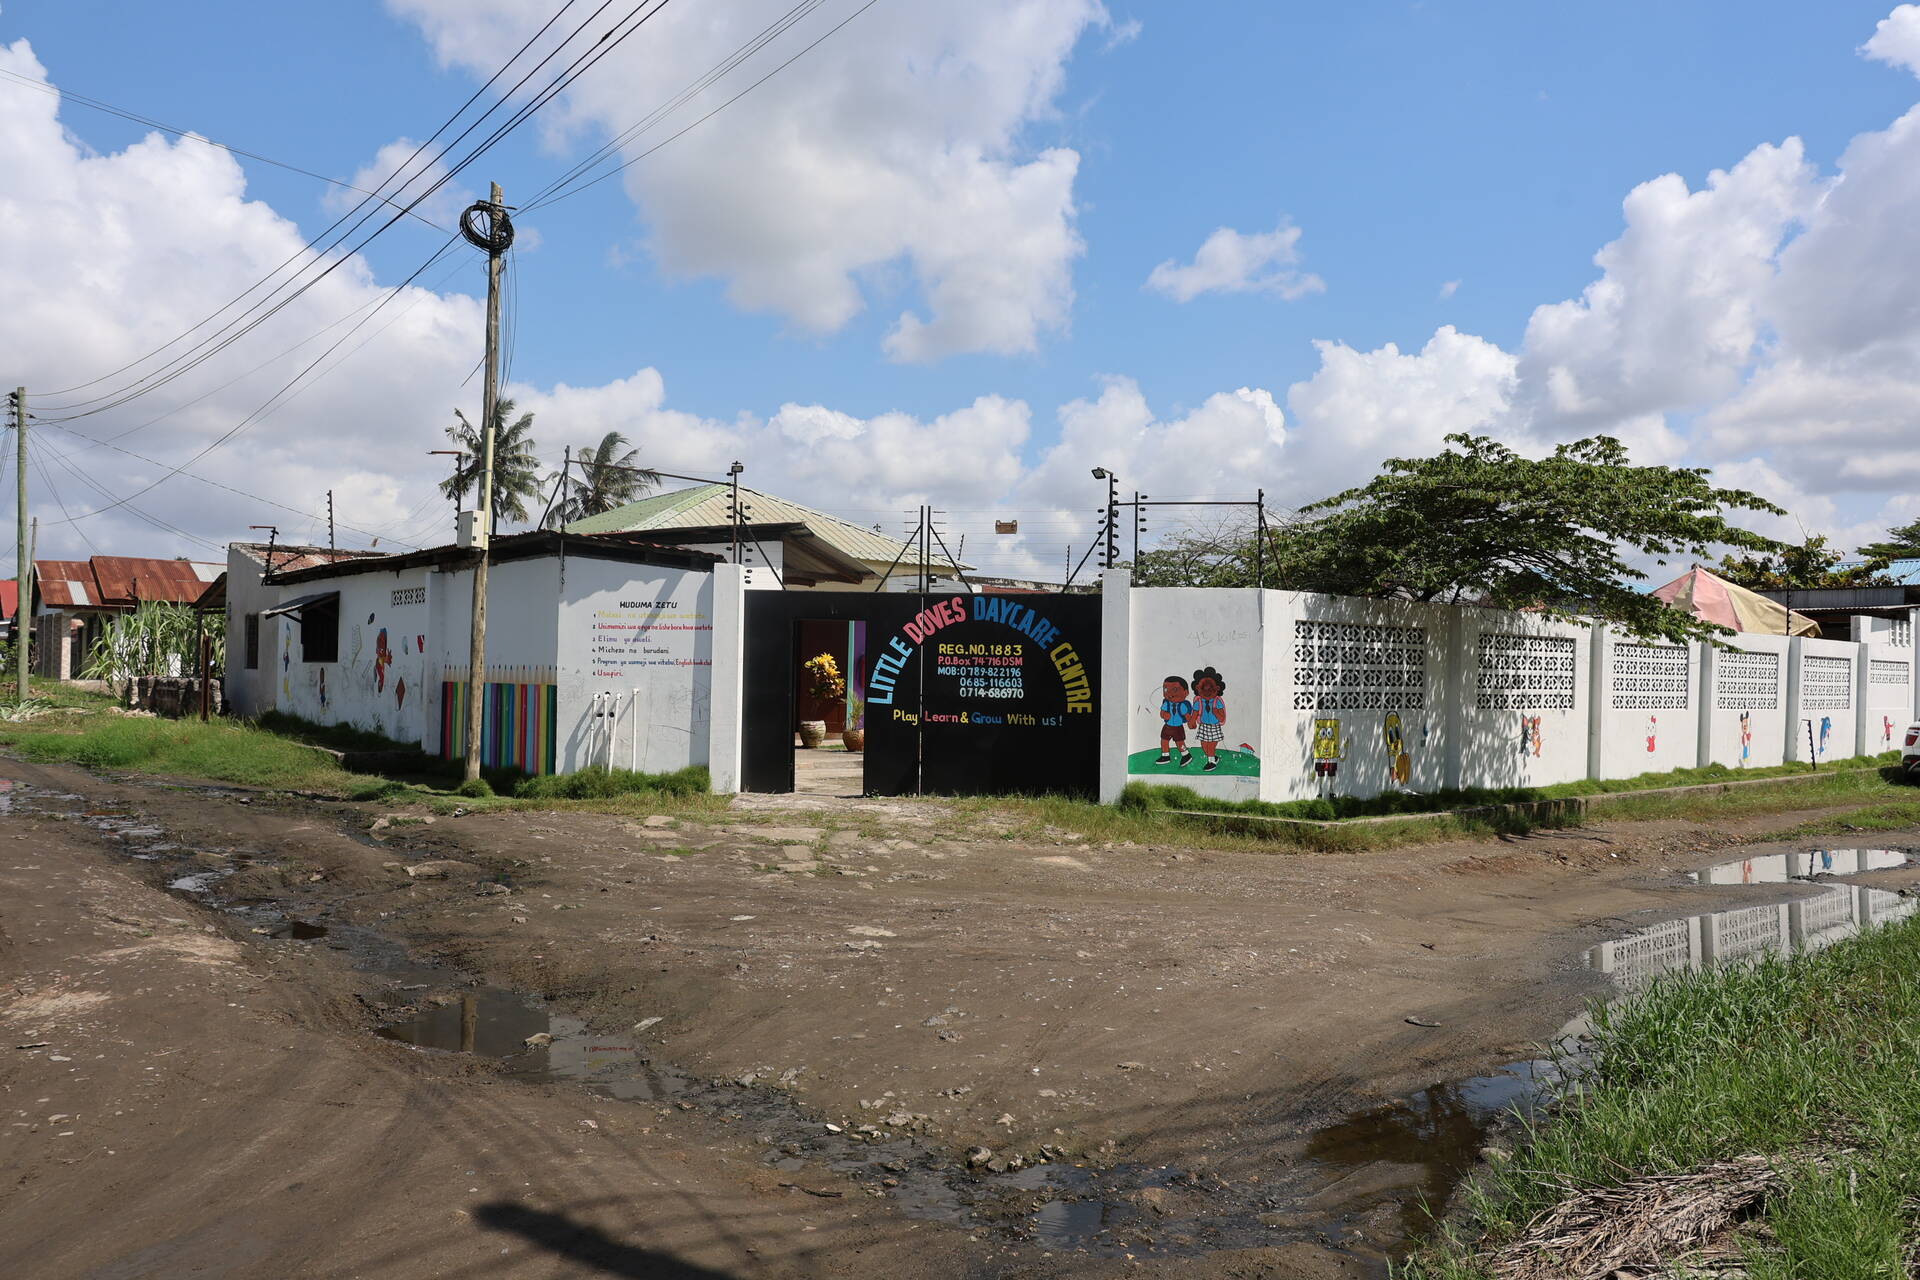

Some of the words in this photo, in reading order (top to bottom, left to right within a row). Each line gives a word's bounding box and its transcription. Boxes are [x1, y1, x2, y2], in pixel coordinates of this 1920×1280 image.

[620, 601, 653, 609] HUDUMA
[655, 601, 678, 609] ZETU
[867, 636, 913, 705] LITTLE
[902, 596, 968, 645] DOVES
[973, 596, 1063, 649] DAYCARE
[1050, 642, 1092, 713] CENTRE
[938, 644, 1023, 656] REG.NO.1883
[1002, 657, 1023, 666] DSM
[960, 677, 1023, 688] 0685-116603
[960, 688, 1024, 699] 0714-686970
[893, 709, 918, 726] Play
[924, 710, 959, 723] Learn
[960, 711, 969, 724] &
[971, 711, 1002, 724] Grow
[1007, 713, 1036, 726] With
